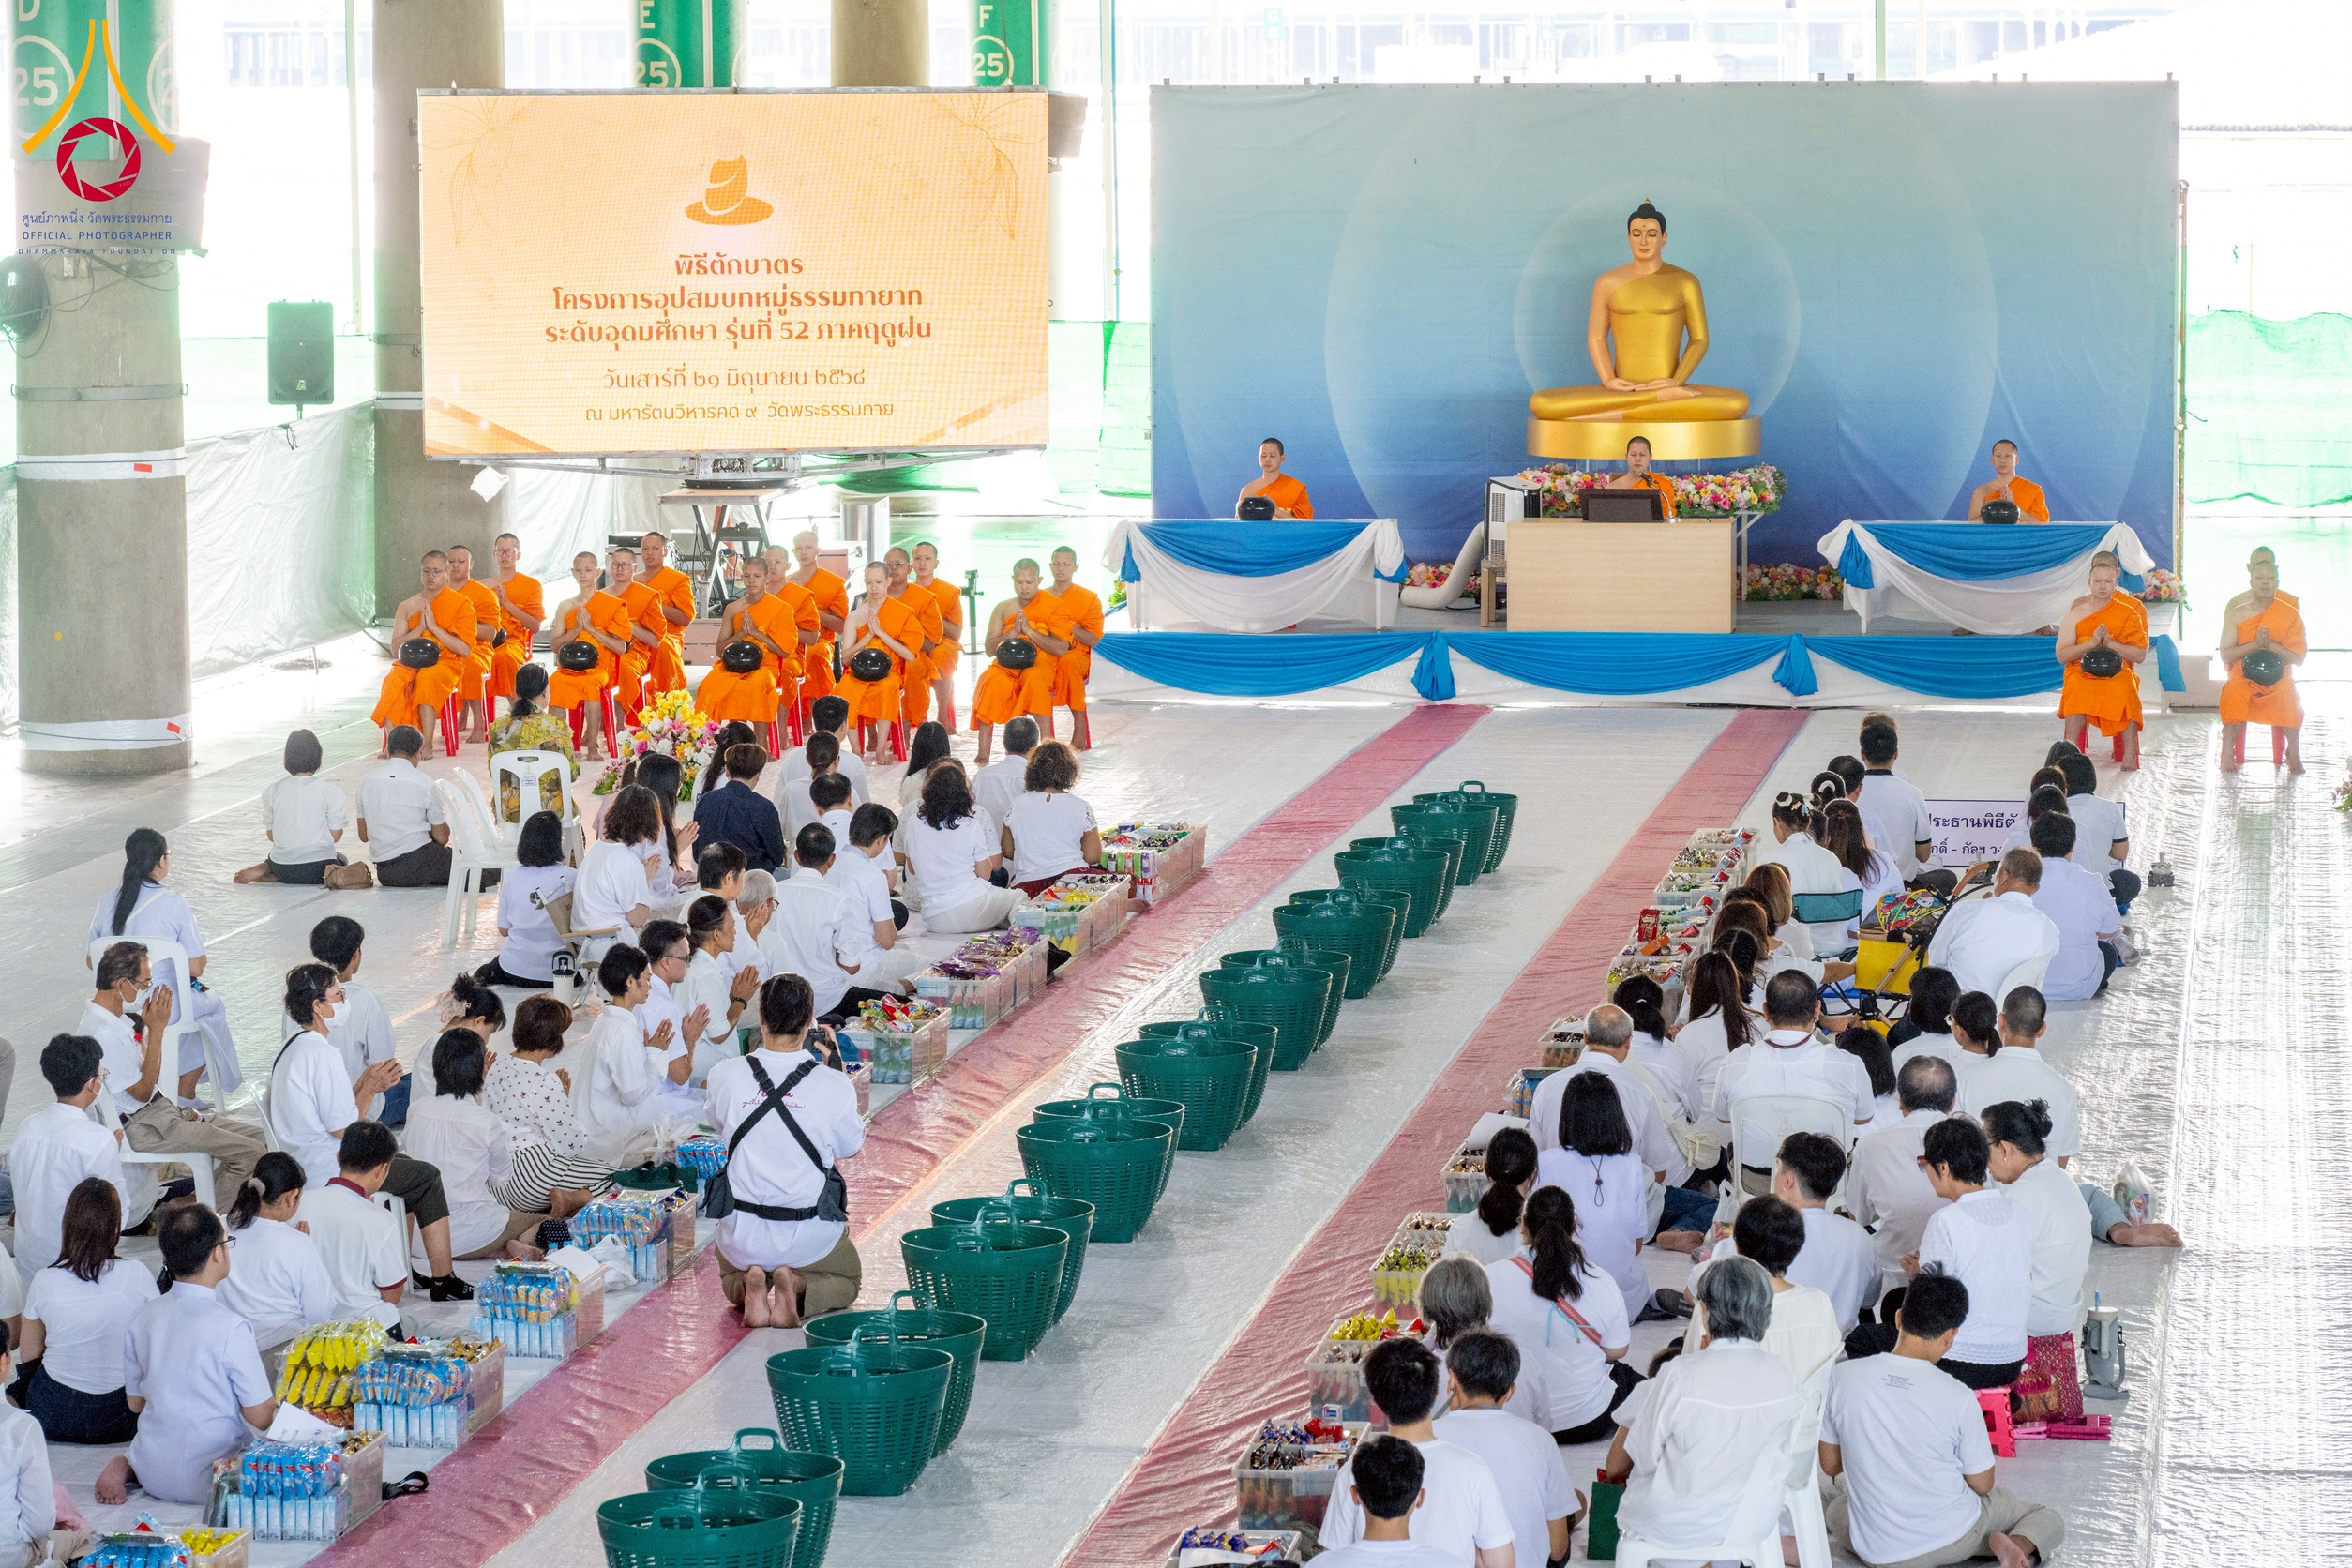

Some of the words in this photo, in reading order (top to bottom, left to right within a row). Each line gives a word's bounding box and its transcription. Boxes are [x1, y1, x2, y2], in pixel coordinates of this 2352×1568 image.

[640, 0, 655, 28] E
[979, 5, 993, 28] F
[634, 61, 669, 88] 25
[972, 53, 1003, 77] 25
[13, 67, 58, 106] 25
[674, 252, 804, 275] พิธีตักบาตร
[552, 283, 922, 317] โครงการอุปสมบทหมู่ธรรมทายาท
[545, 319, 717, 351] ระดับอุดมศึกษา
[726, 311, 772, 350] รุ่นที่
[780, 322, 809, 339] 52
[817, 315, 931, 348] ภาคฤดูฝน
[603, 362, 686, 388] วันเสาร์ที่
[694, 371, 719, 388] ๒๑
[727, 369, 807, 394] มิถุนายน
[815, 369, 866, 385] ๒๕๖๘
[585, 408, 602, 421] ณ
[609, 403, 739, 420] มหารัตนวิหารคด
[767, 401, 895, 418] วัดพระธรรมกาย
